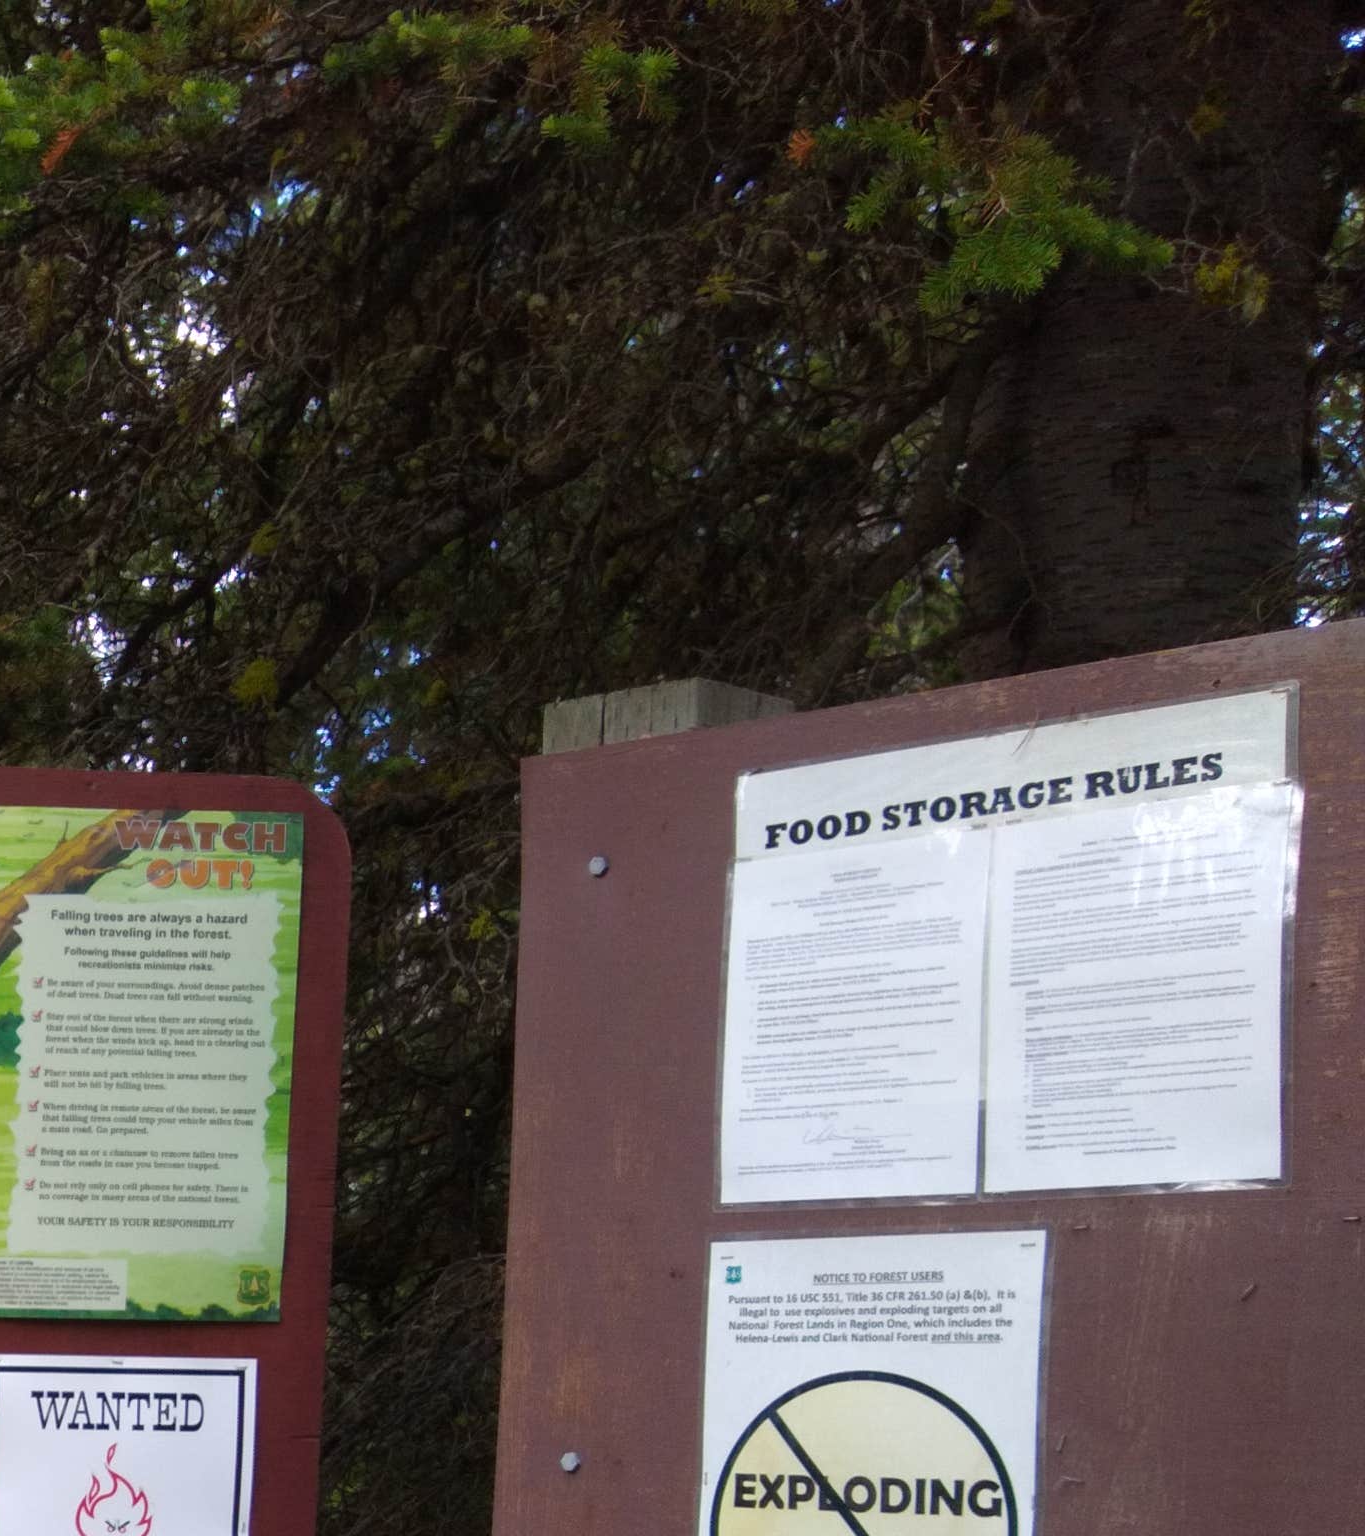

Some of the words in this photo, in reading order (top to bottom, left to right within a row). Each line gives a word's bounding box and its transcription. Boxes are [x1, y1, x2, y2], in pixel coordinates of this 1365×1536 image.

[765, 811, 871, 848] FOOD
[882, 777, 1072, 829] STORAGE
[1085, 753, 1222, 798] RULES
[114, 820, 287, 853] WATCH
[146, 859, 255, 890] OUT!
[51, 909, 90, 923] Falling
[94, 912, 123, 921] trees
[127, 914, 146, 922] are
[150, 913, 191, 925] always
[195, 915, 202, 923] a
[206, 913, 247, 924] hazard
[64, 926, 95, 936] when
[99, 927, 151, 940] traveling
[155, 928, 166, 938] in
[170, 928, 189, 938] the
[193, 929, 231, 939] forest.
[813, 1272, 850, 1284] NOTICE
[853, 1272, 867, 1283] TO
[869, 1271, 908, 1283] FOREST
[910, 1270, 944, 1281] USERS
[735, 1334, 798, 1343] Helena-Lewis
[801, 1334, 820, 1342] and
[822, 1332, 847, 1342] Clark
[851, 1332, 893, 1342] National
[896, 1332, 927, 1341] Forest
[931, 1332, 951, 1342] and
[954, 1331, 973, 1342] this
[976, 1333, 1003, 1342] area.
[31, 1391, 203, 1431] WANTED
